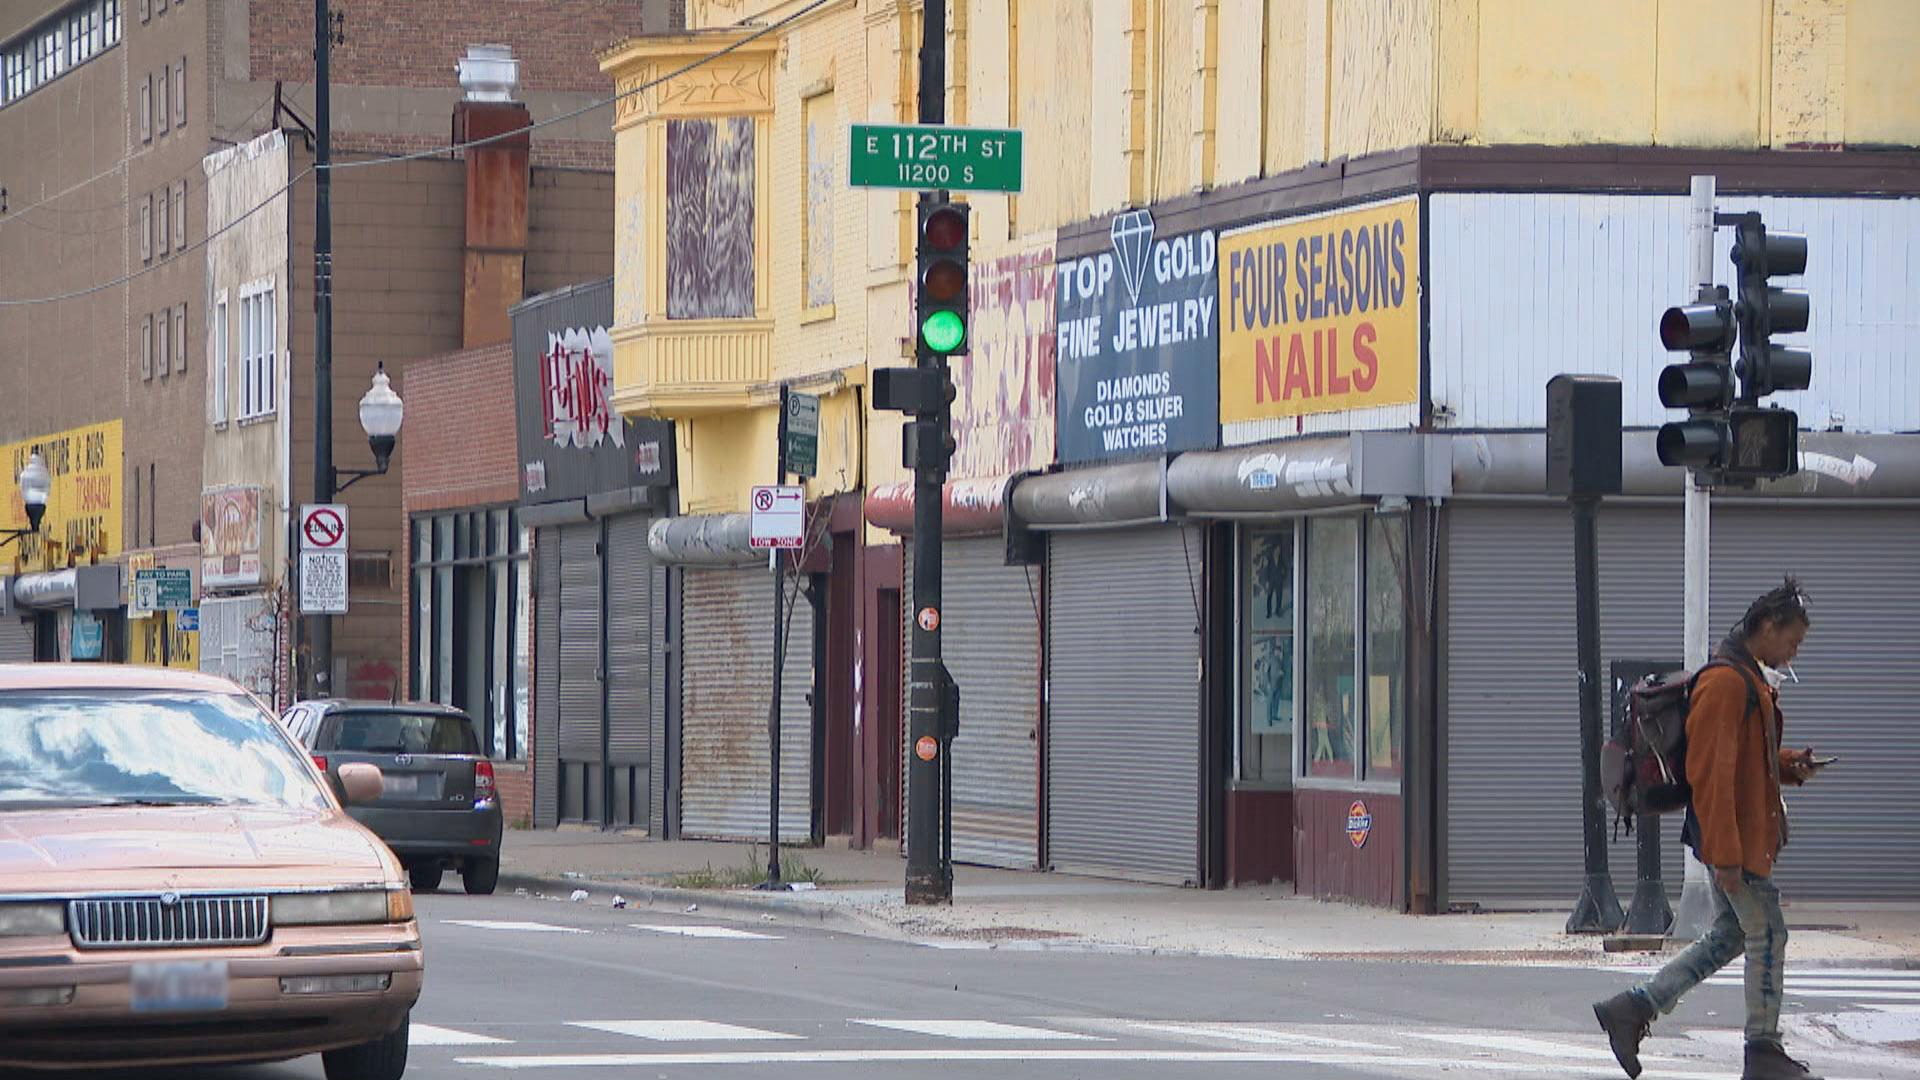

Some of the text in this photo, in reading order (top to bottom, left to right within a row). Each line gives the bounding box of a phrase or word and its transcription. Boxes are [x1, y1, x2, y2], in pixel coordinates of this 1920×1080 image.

[866, 133, 1006, 160] E 112TH ST
[898, 163, 974, 183] 11200 S
[1058, 229, 1217, 302] TOP GOLD
[1230, 219, 1406, 333] FOUR SEASONS
[1057, 314, 1101, 363] FINE
[1112, 295, 1215, 353] JEWELRY
[1255, 321, 1380, 406] NAILS
[1096, 371, 1171, 402] DIAMONDS
[1084, 395, 1184, 428] GOLD & SILVER
[1103, 423, 1168, 451] WATCHES
[754, 537, 797, 547] TOW ZONE
[309, 555, 339, 565] NOTICE
